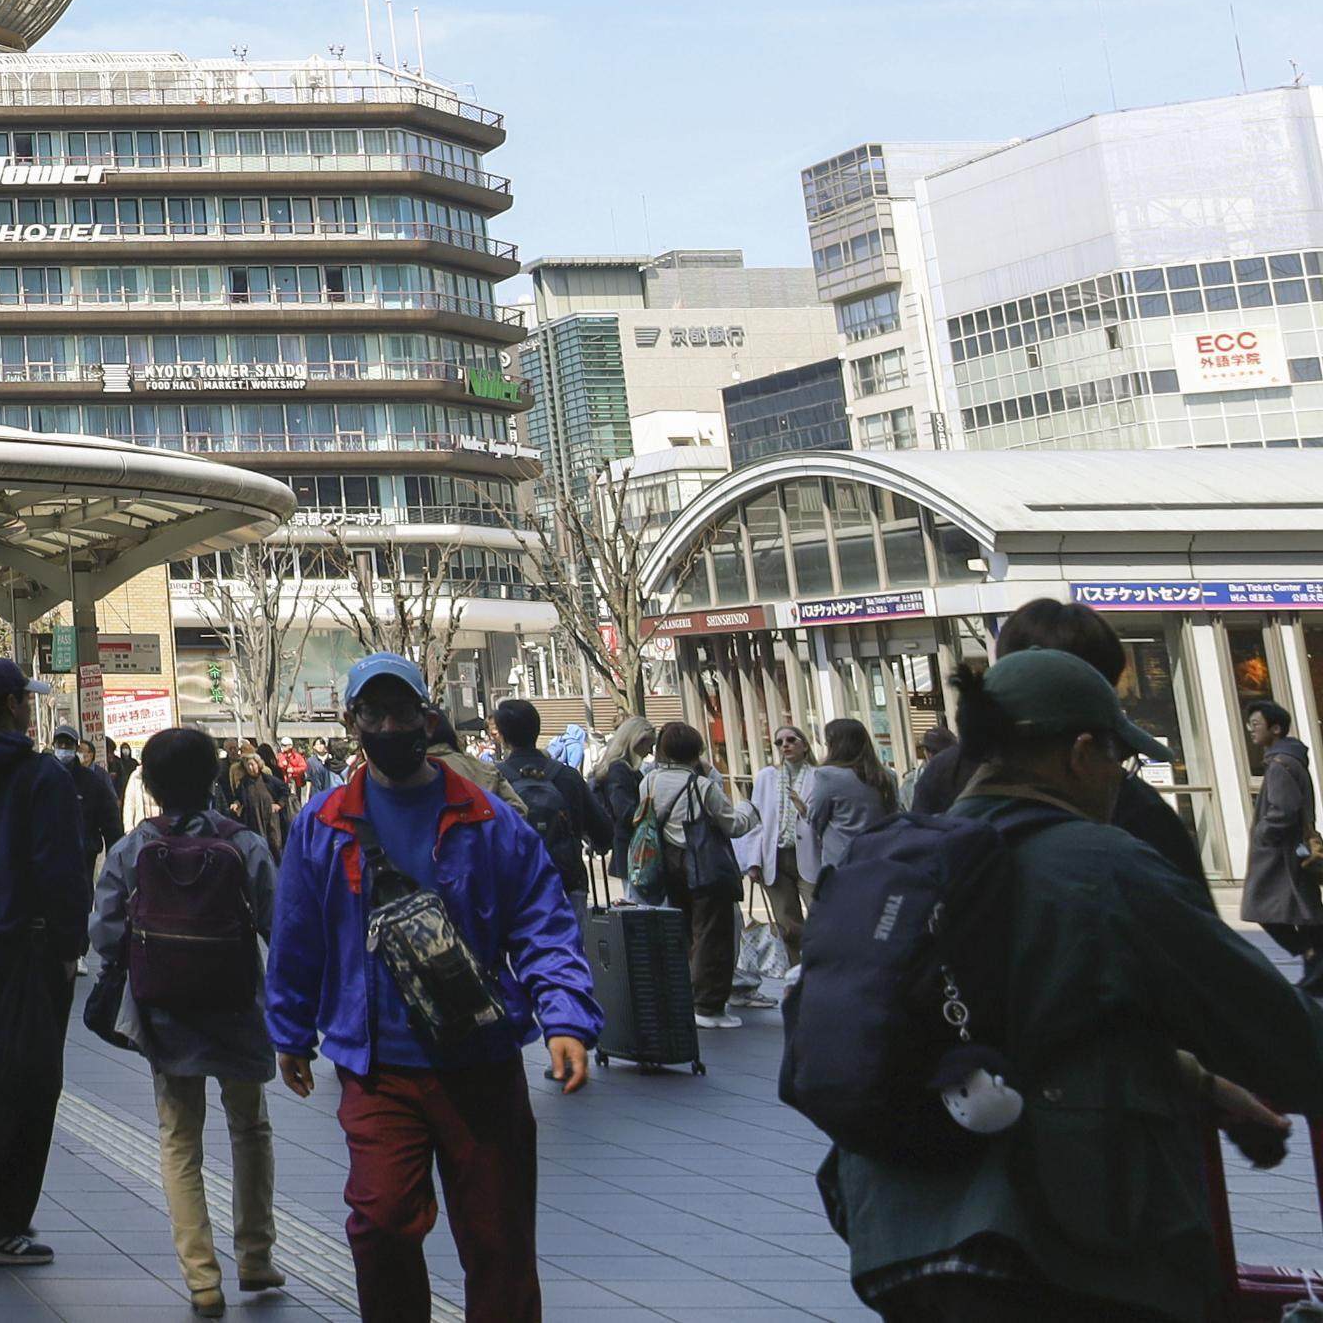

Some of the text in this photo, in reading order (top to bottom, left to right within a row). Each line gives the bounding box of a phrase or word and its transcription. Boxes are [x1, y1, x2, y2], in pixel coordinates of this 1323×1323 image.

[669, 326, 744, 347] 京都銀行
[1196, 332, 1257, 353] ECC
[1201, 353, 1261, 368] 外語学院
[145, 364, 306, 378] KYOTO TOWER SANDO
[146, 380, 306, 390] FOOD HALL MARKET WORKSHOP
[1076, 586, 1217, 602] バスチケットセンター
[1228, 583, 1301, 592] Bus Ticket Center
[801, 601, 863, 618] バスチケットセンター
[706, 612, 749, 627] SHINSHINDO
[57, 635, 71, 645] PASS
[874, 894, 903, 941] THULE
